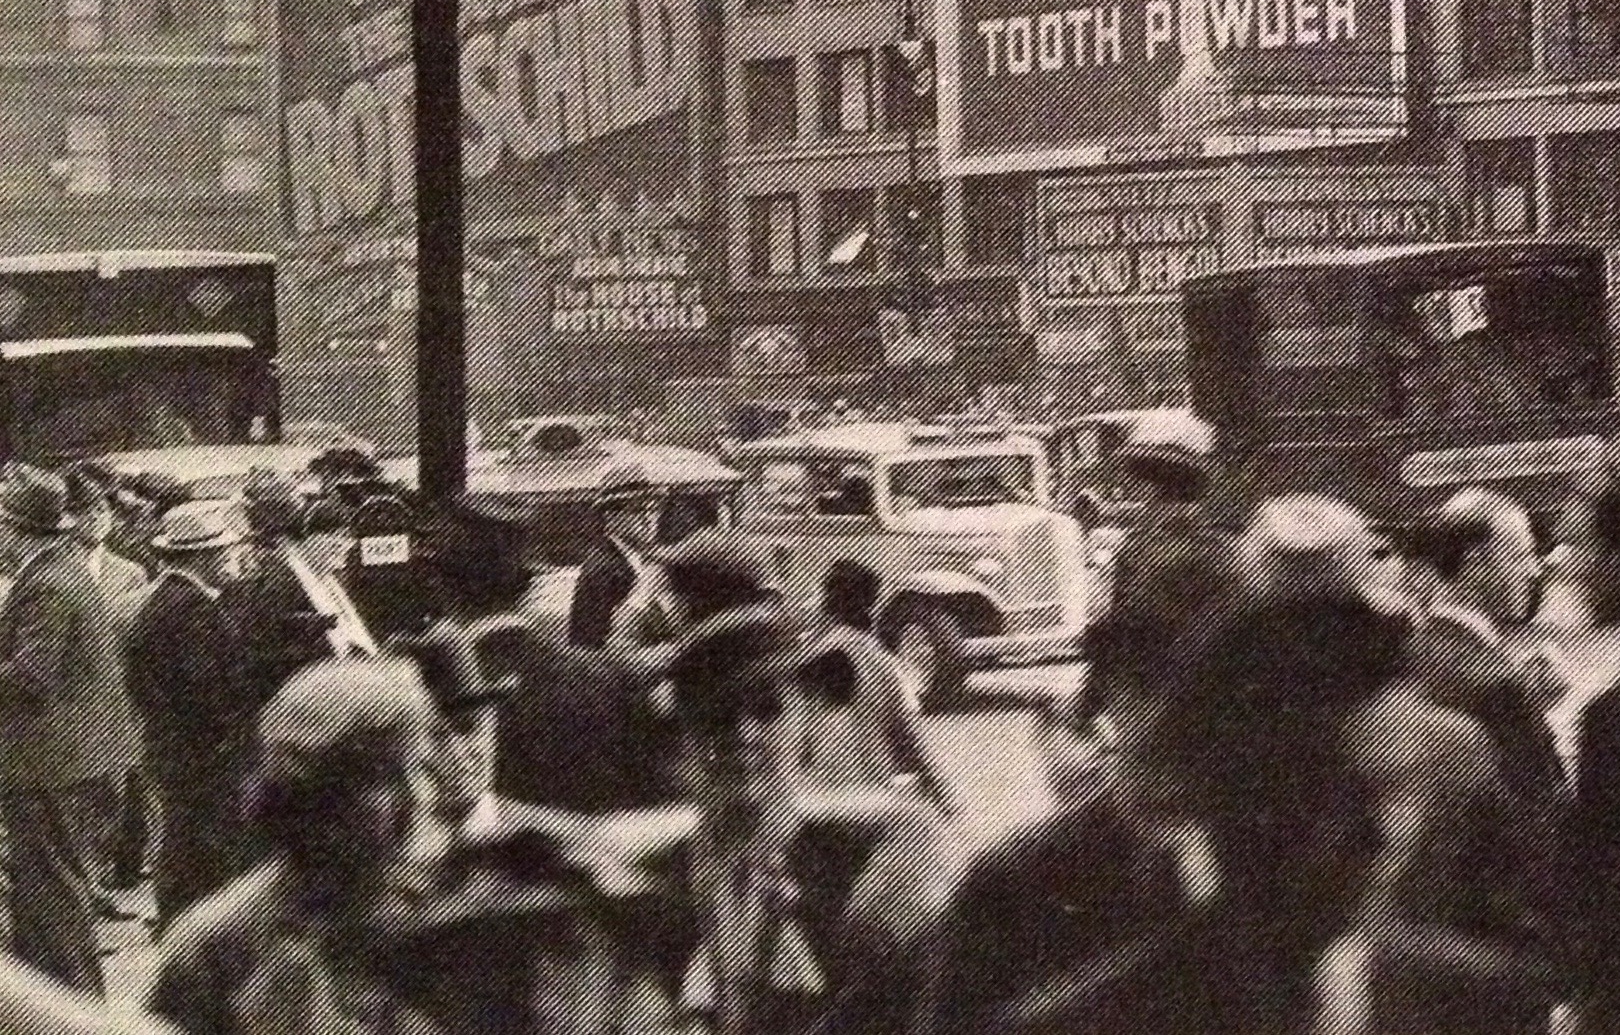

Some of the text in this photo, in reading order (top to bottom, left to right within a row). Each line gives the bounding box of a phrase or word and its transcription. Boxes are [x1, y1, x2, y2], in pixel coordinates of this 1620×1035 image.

[977, 3, 1123, 78] TOOTH
[1046, 249, 1133, 297] BEYOND
[591, 280, 677, 307] HOUSE
[551, 304, 710, 333] ROTHSCHILD
